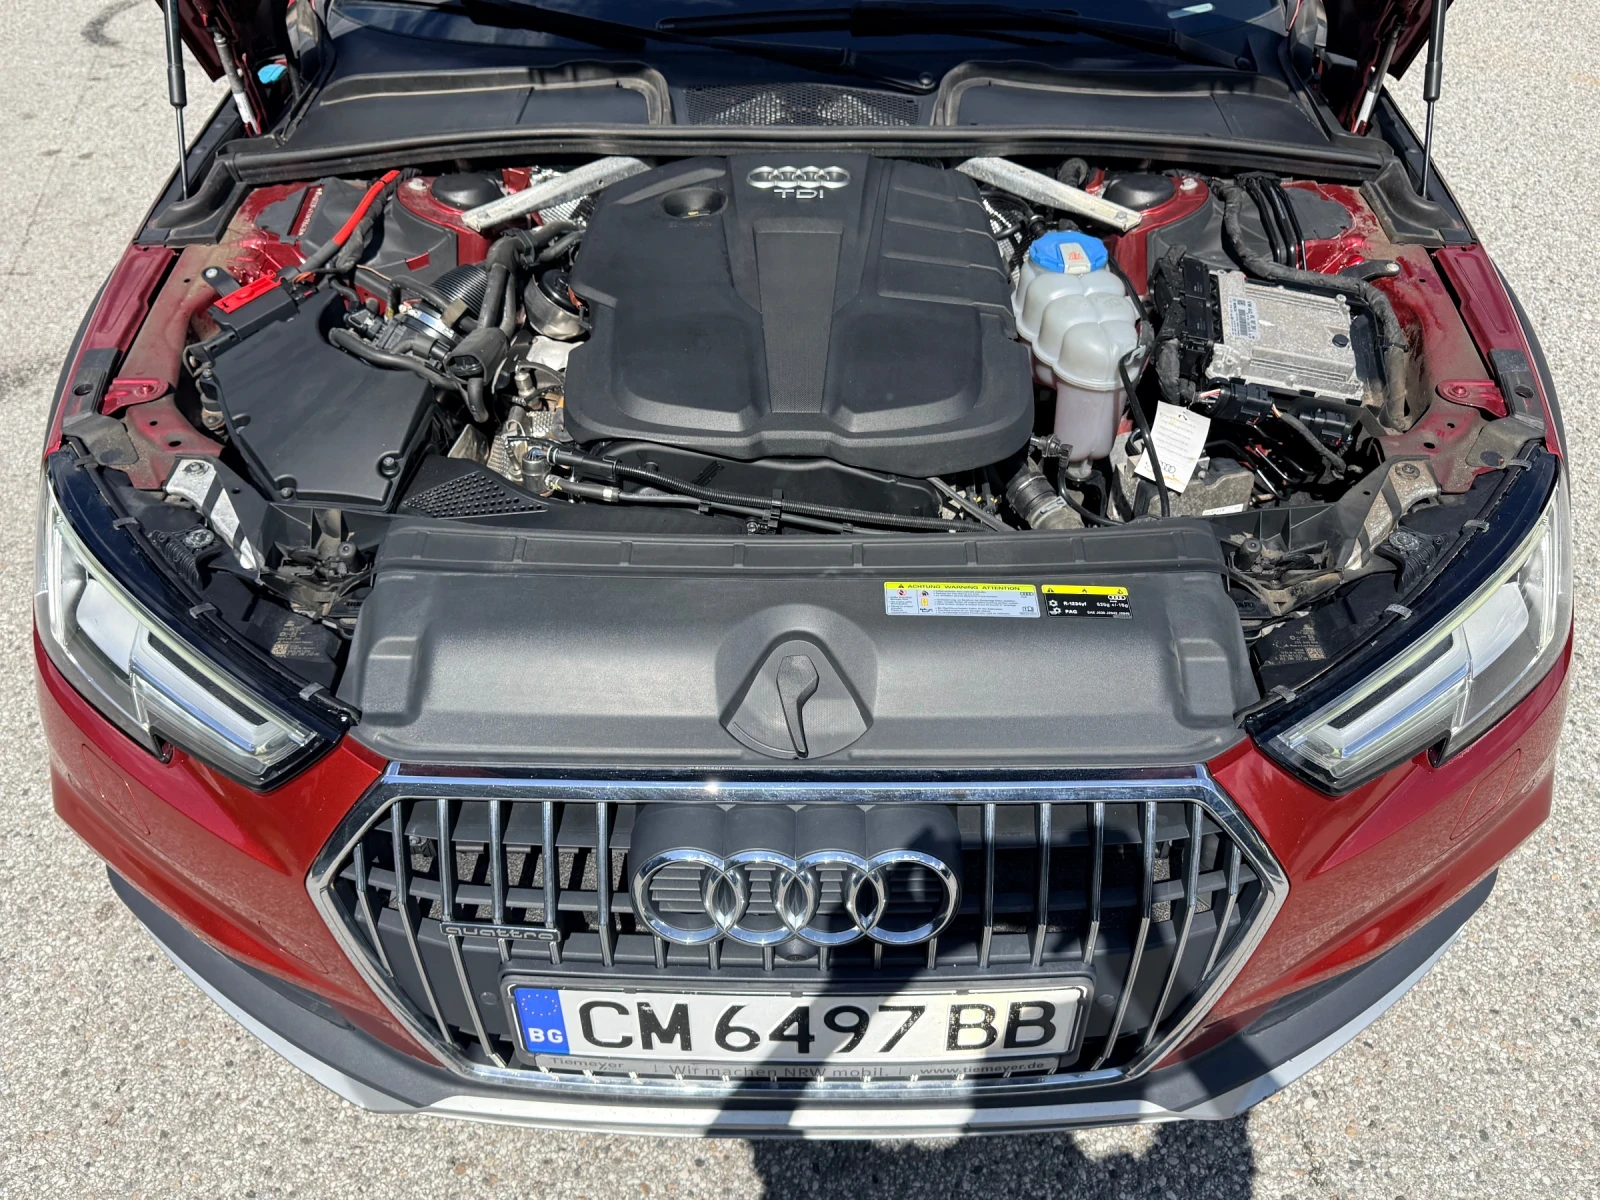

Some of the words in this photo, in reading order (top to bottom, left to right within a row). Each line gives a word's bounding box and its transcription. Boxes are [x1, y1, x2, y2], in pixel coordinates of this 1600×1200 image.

[773, 188, 825, 199] TDI
[445, 926, 554, 940] quattro
[578, 999, 693, 1052] CM
[714, 1001, 926, 1054] 6497
[945, 1000, 1057, 1052] BB
[527, 1027, 563, 1044] BG
[549, 1058, 625, 1071] Tiemeyer
[669, 1064, 700, 1076] Wir
[705, 1064, 778, 1078] machen
[784, 1066, 827, 1078] NRW
[832, 1066, 889, 1077] mobil.
[919, 1061, 1045, 1074] www.tiemeyer.de
